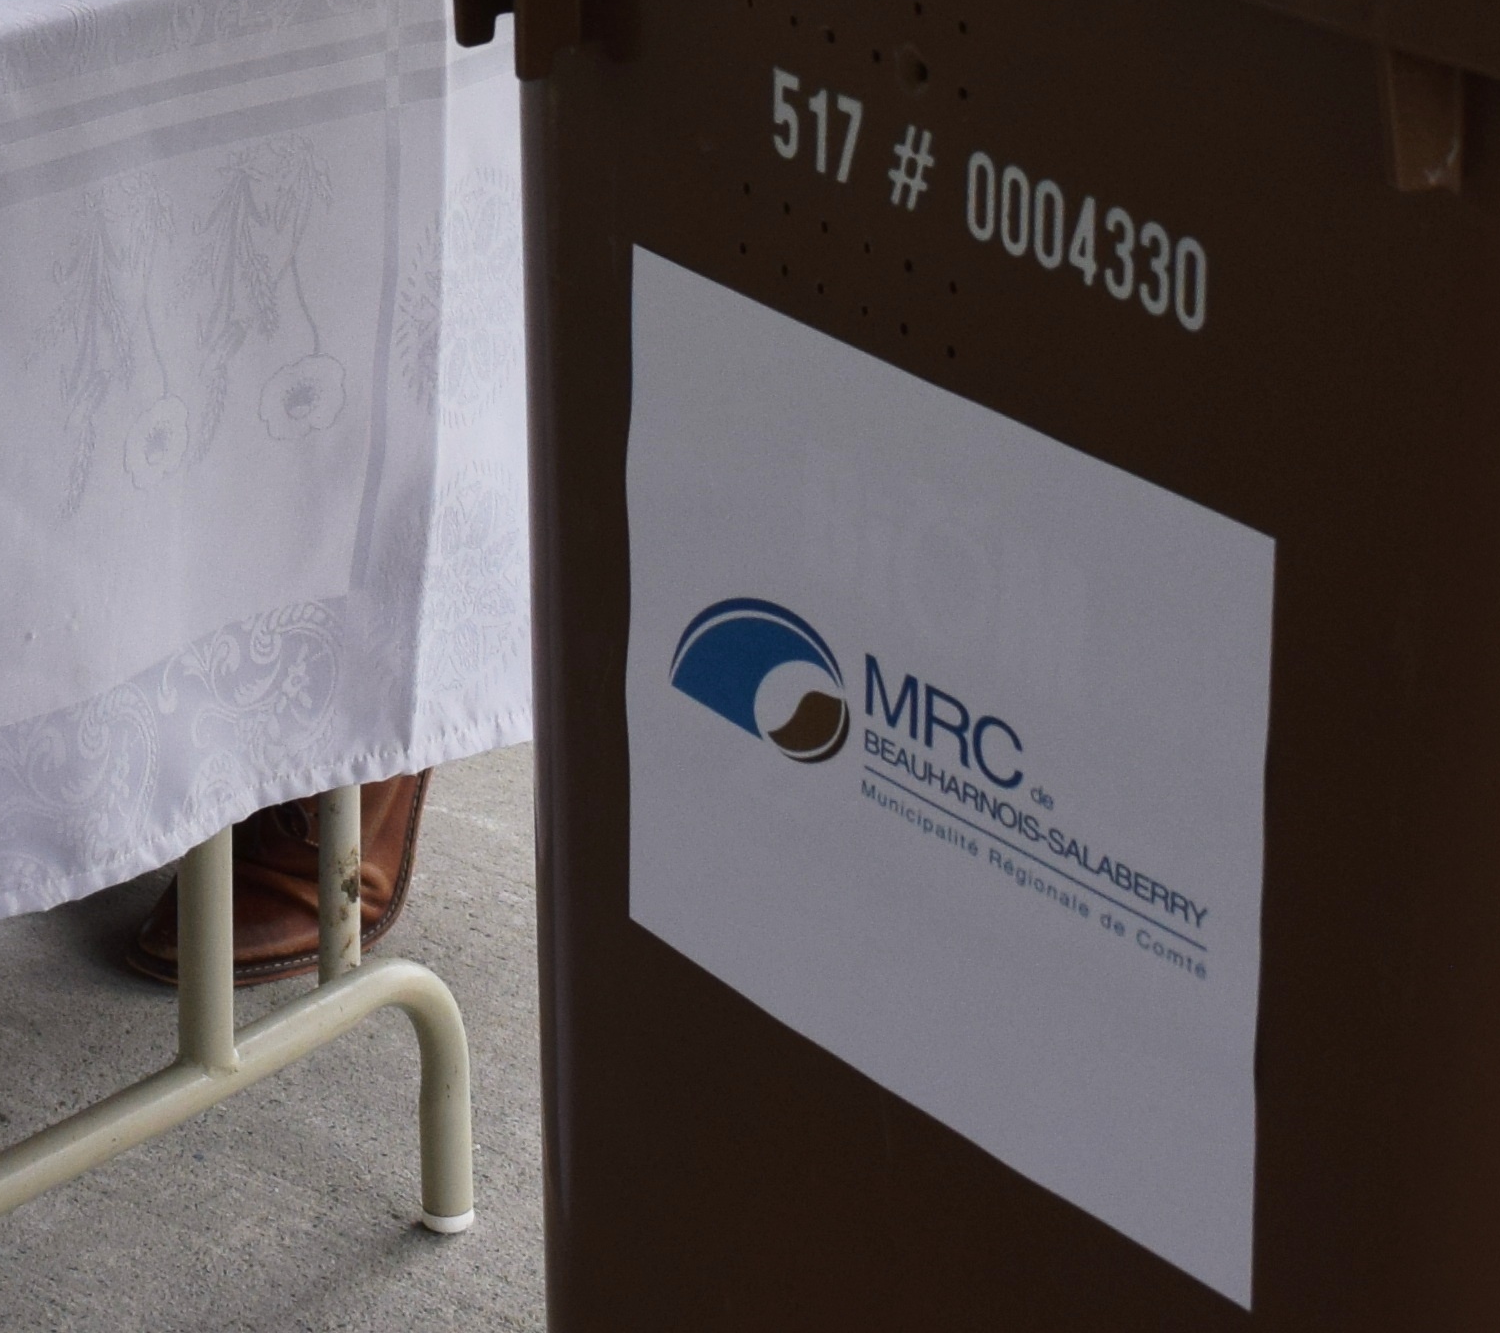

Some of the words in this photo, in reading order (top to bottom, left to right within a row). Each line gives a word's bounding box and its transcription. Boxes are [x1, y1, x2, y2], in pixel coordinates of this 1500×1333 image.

[772, 66, 864, 185] 517
[887, 124, 935, 211] #
[966, 149, 1208, 332] 0004330
[863, 729, 1208, 928] BEAUHARNOIS-SALABERRY
[864, 653, 1023, 791] MRC
[1029, 784, 1055, 811] de
[861, 779, 978, 858] Municipalité
[988, 850, 1090, 918] Régionale
[1100, 907, 1126, 937] de
[1136, 926, 1207, 980] Comté
